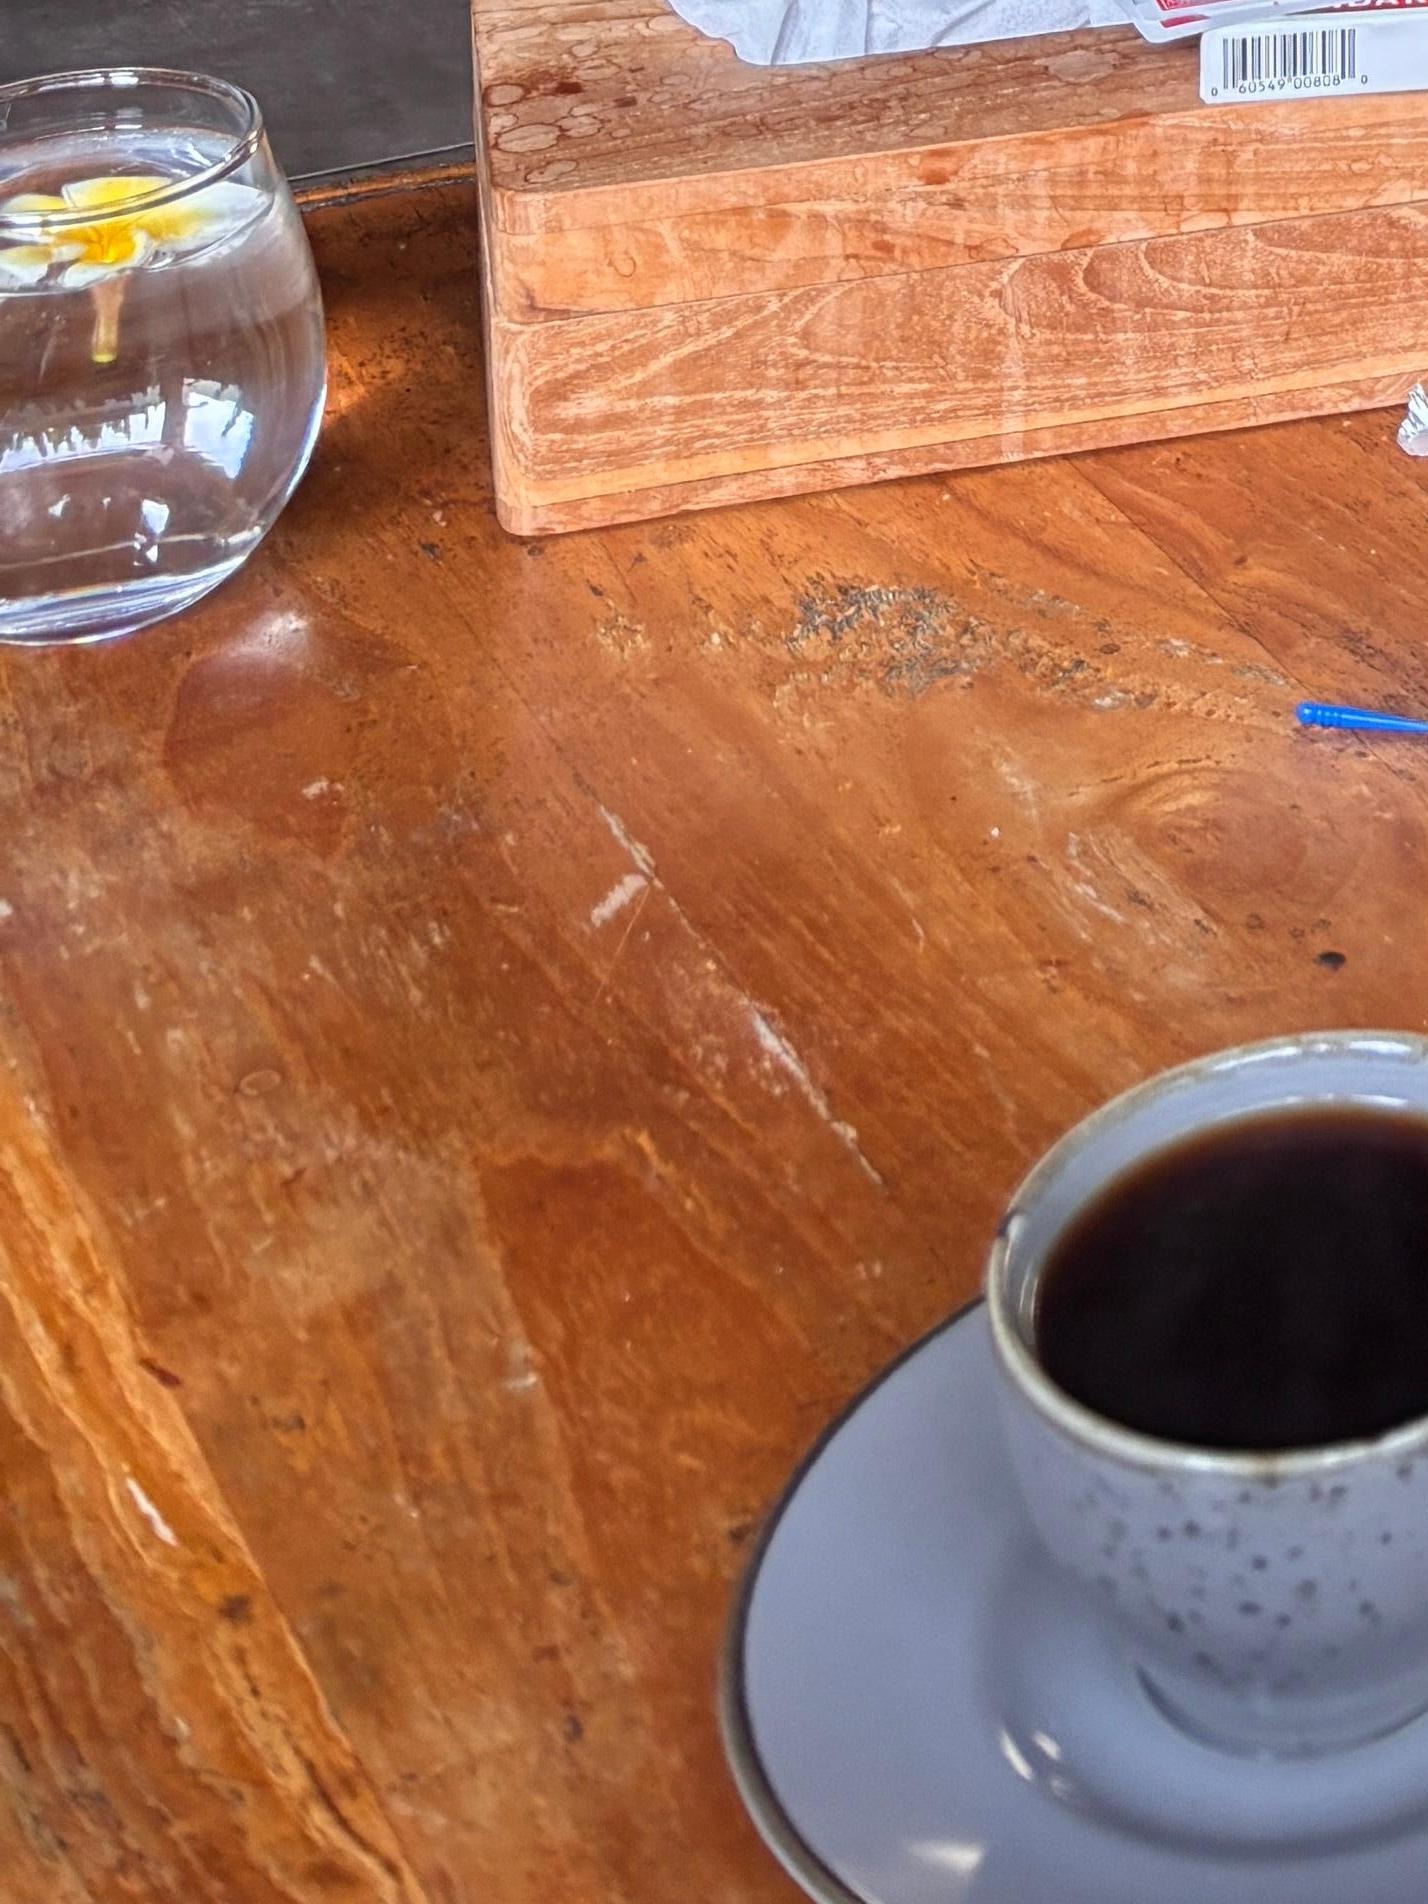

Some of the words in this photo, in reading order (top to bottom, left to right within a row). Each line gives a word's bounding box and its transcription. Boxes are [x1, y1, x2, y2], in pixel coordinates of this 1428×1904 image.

[1211, 87, 1218, 96] 0
[1238, 79, 1286, 94] 60549
[1293, 75, 1341, 90] 00808
[1360, 74, 1368, 84] 0
